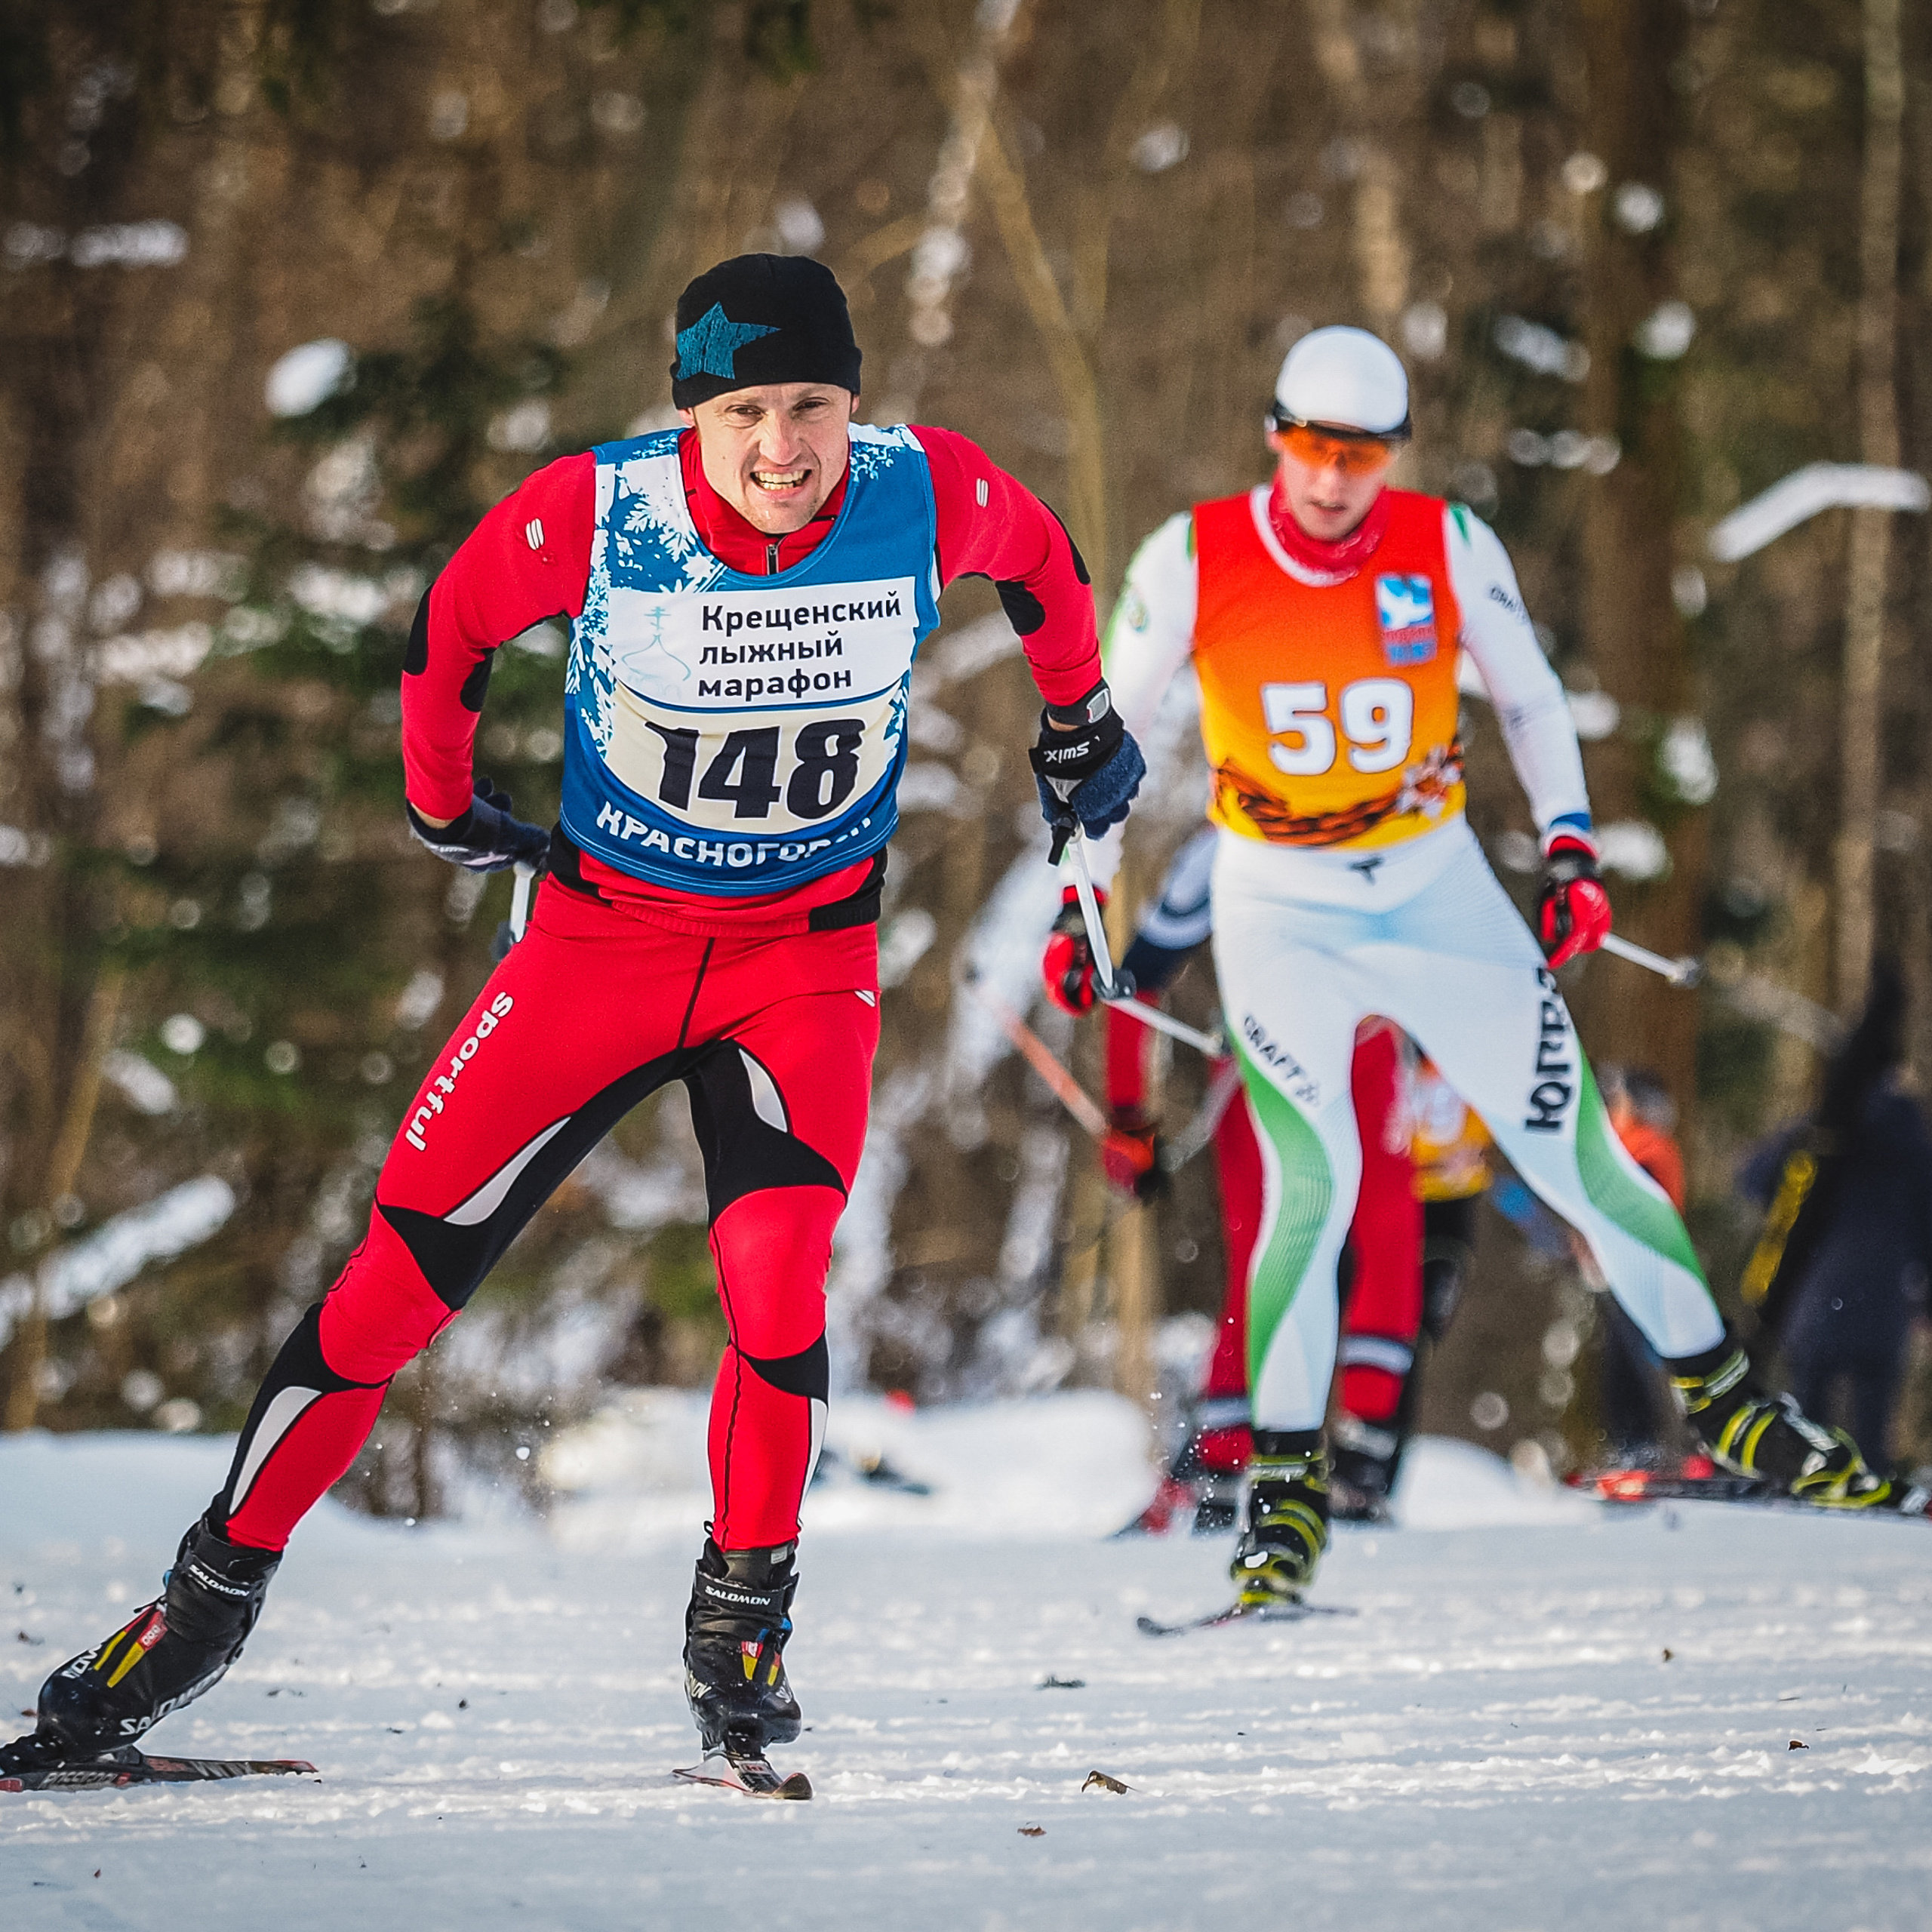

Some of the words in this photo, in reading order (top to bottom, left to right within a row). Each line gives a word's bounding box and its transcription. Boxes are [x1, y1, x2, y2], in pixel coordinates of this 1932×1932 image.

[701, 591, 903, 636] Крещенский
[699, 631, 844, 665] лыжный
[698, 669, 852, 701] марафон
[1262, 678, 1414, 776] 59
[644, 718, 866, 820] 148
[405, 991, 515, 1152] sportful
[189, 1564, 250, 1597] SALOMON
[705, 1585, 771, 1605] SALOMON
